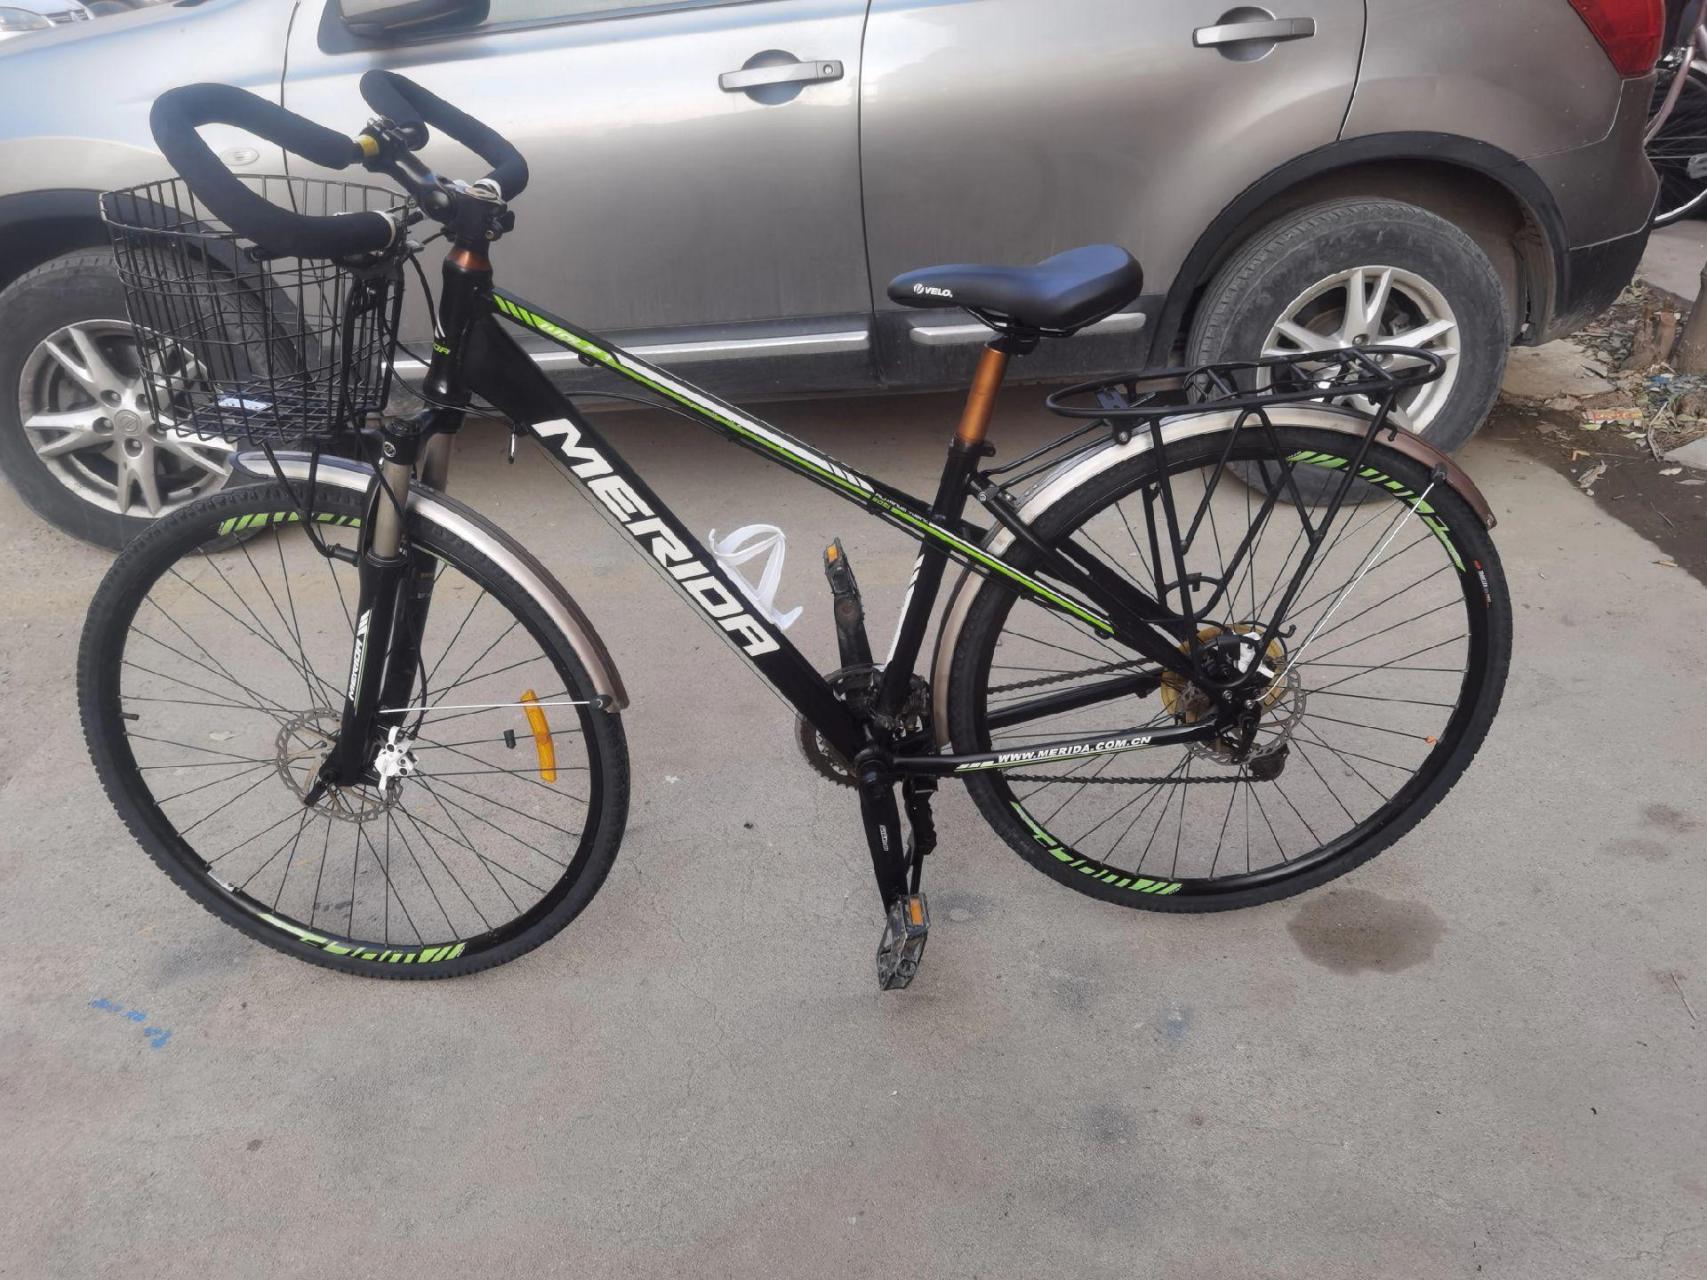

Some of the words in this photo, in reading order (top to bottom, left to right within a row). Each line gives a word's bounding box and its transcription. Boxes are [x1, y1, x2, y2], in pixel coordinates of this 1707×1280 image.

[925, 286, 951, 297] VELO
[532, 418, 780, 657] MERIDA
[998, 736, 1152, 763] WWW.MERIDA.COM.CN
